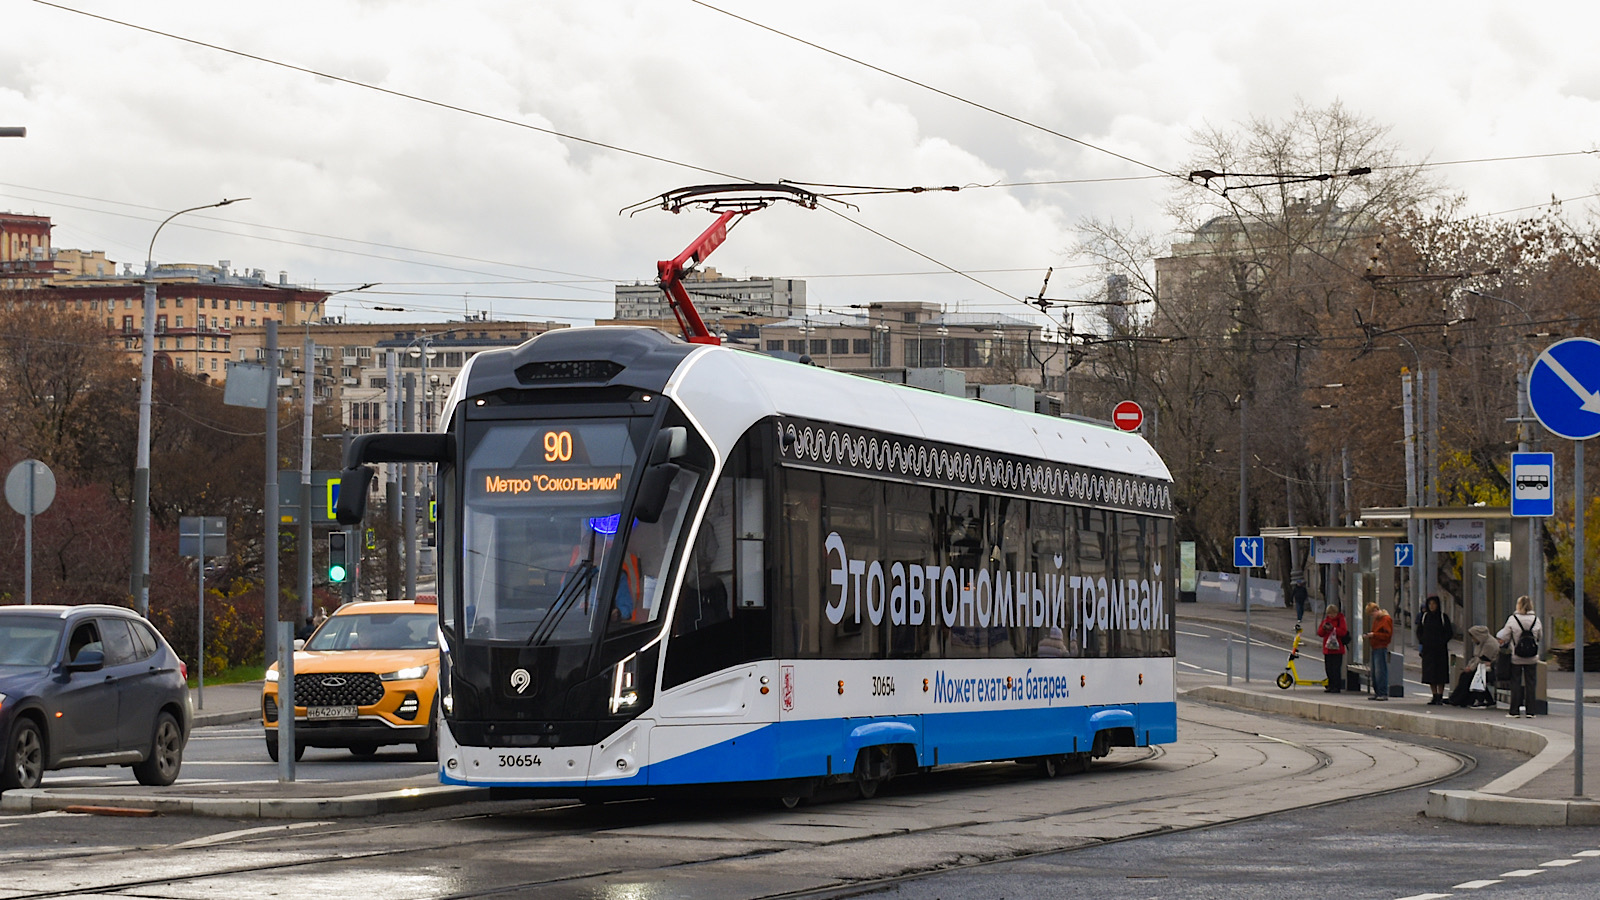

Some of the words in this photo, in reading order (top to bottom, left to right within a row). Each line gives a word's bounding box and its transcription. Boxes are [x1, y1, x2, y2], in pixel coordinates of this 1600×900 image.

[543, 431, 573, 462] 90
[486, 475, 532, 495] Метро
[533, 473, 622, 492] "Сокольники"
[824, 531, 885, 626] Это
[890, 552, 1065, 629] автономный
[1069, 561, 1170, 649] трамвай.
[872, 676, 896, 696] 30654
[934, 670, 976, 704] Может
[977, 678, 1008, 703] ехать
[1011, 677, 1023, 700] на
[1026, 667, 1070, 706] батарее.
[499, 754, 542, 767] 30654
